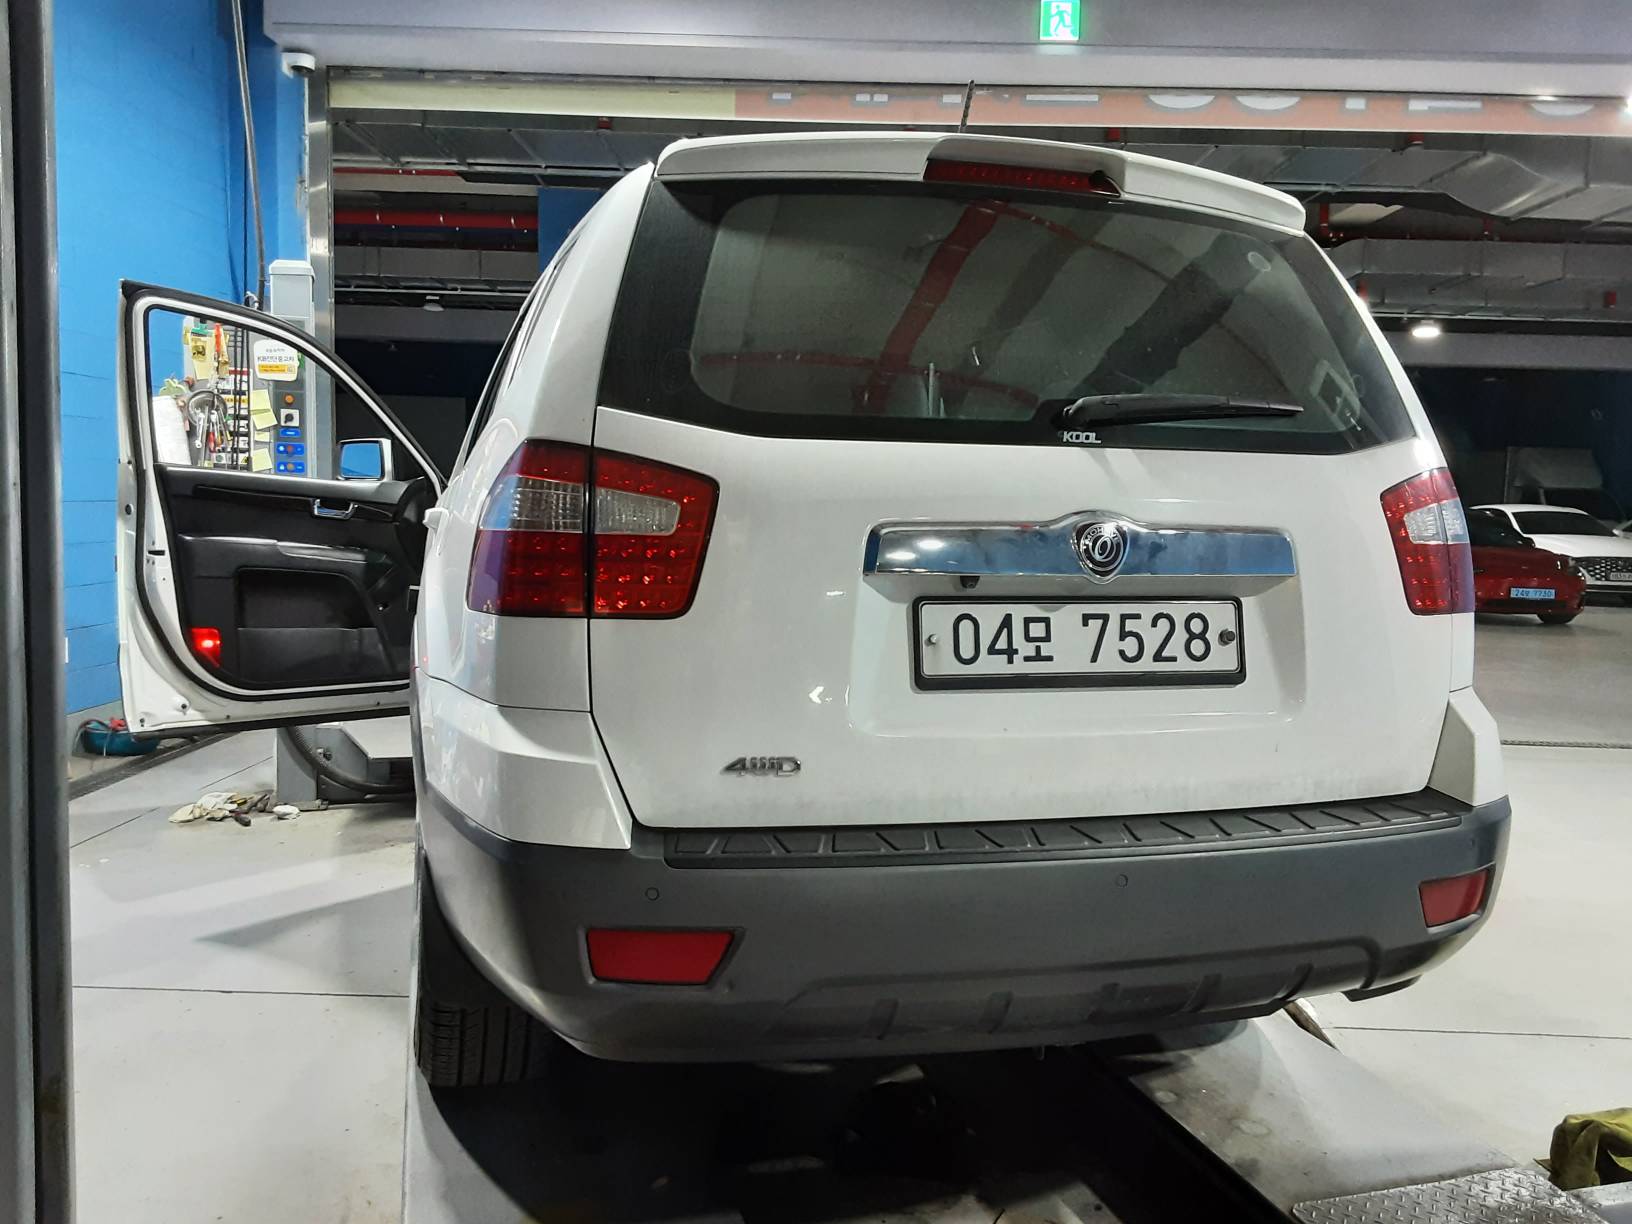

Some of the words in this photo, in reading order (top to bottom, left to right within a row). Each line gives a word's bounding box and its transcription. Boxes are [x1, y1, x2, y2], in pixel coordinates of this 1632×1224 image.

[1063, 431, 1102, 443] KOOL
[952, 612, 1054, 666] 04모
[1081, 611, 1212, 664] 7528
[723, 756, 801, 776] 4WD
